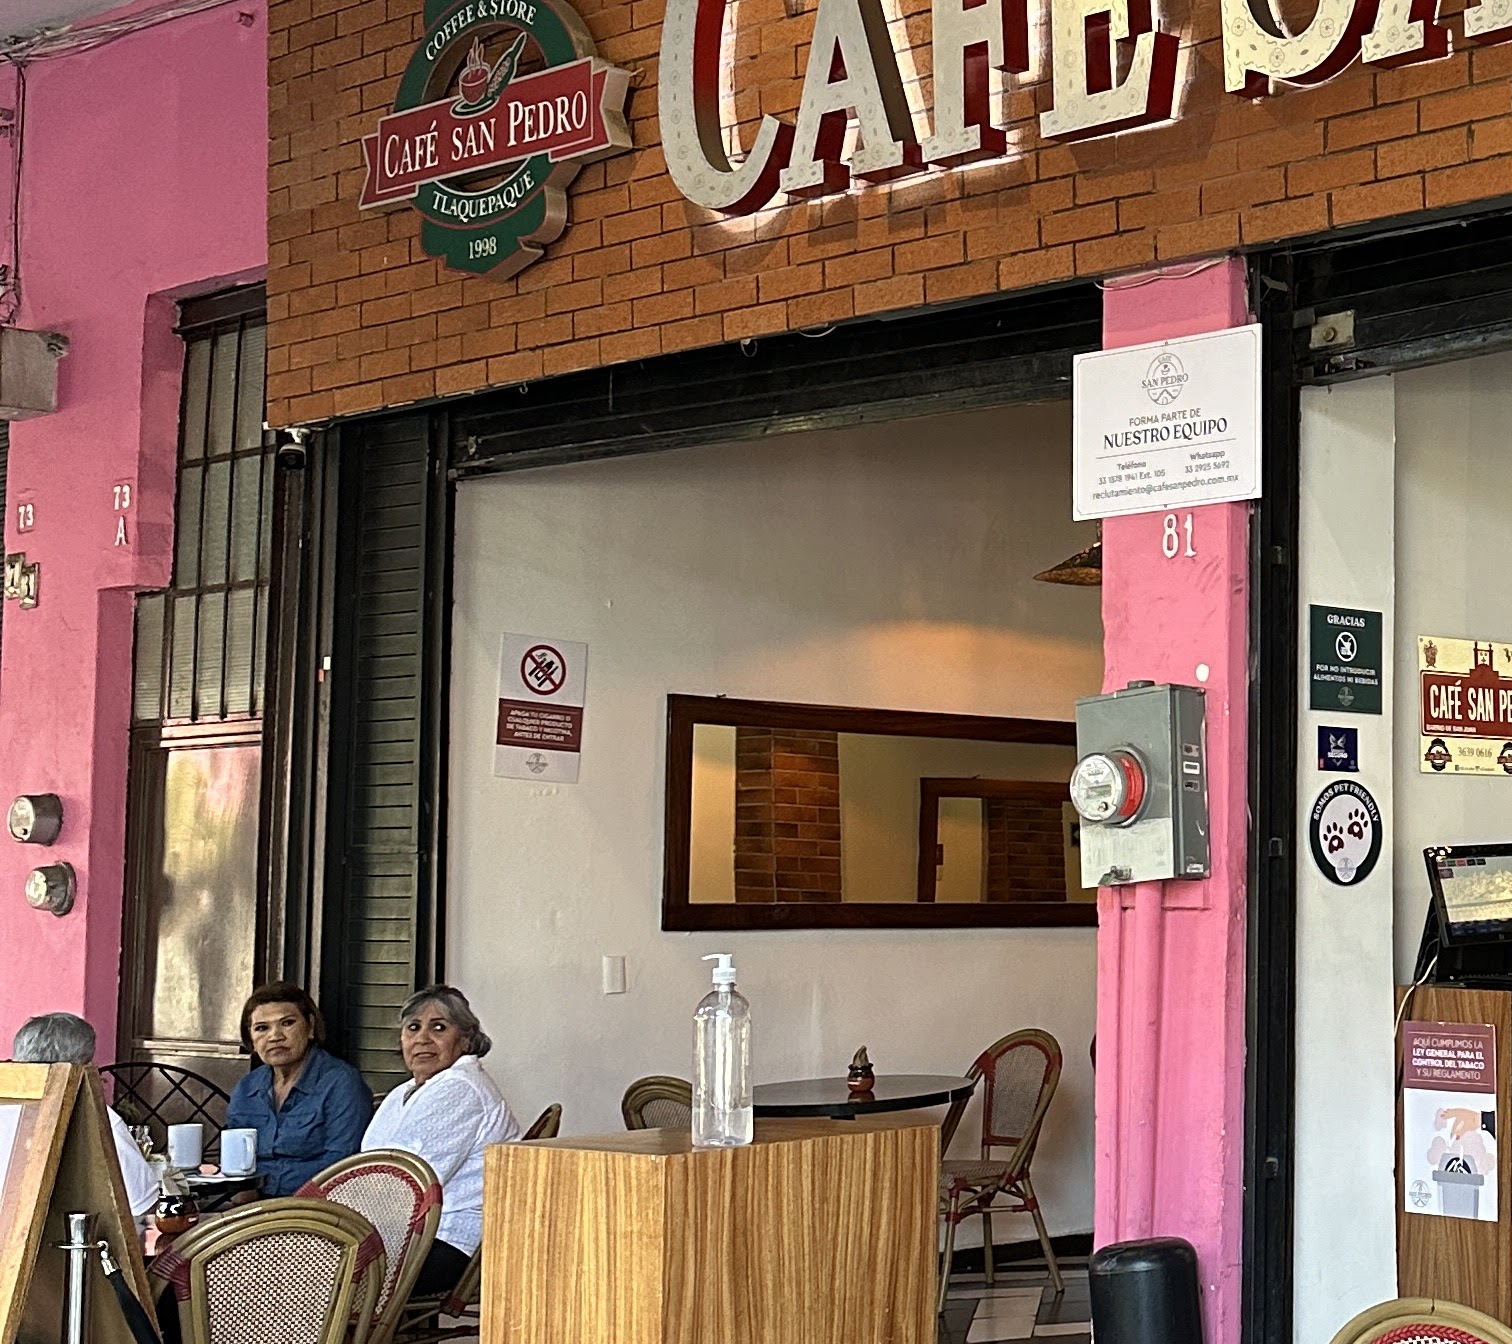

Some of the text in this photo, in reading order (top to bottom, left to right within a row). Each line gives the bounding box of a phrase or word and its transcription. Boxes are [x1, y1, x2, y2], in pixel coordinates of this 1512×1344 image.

[426, 3, 474, 61] COFFEE
[477, 0, 488, 18] &
[385, 90, 587, 178] CAFÉ SAN PEDRO
[432, 170, 535, 223] TLAQUEPAQUE
[469, 236, 497, 259] 1998
[1141, 373, 1189, 388] SAN PEDRO
[1129, 408, 1201, 427] FORMA PARTE DE
[1103, 417, 1228, 449] NUESTRO EQUIPO
[113, 484, 131, 511] 73
[18, 503, 34, 529] 73
[114, 515, 127, 546] A
[1162, 513, 1197, 559] 81
[1327, 614, 1366, 627] GRACIAS
[1429, 679, 1463, 720] CAFÉ
[1467, 687, 1494, 722] SAN
[1313, 783, 1379, 822] SOMOS PET FRIENDLY
[1412, 1047, 1484, 1060] LEY GENERAL PARA EL
[1413, 1036, 1483, 1049] AQUÍ CUMPLIMOS LA
[1412, 1057, 1485, 1070] CONTROL DEL TABACO
[1416, 1068, 1481, 1080] Y SU REGLAMENTO
